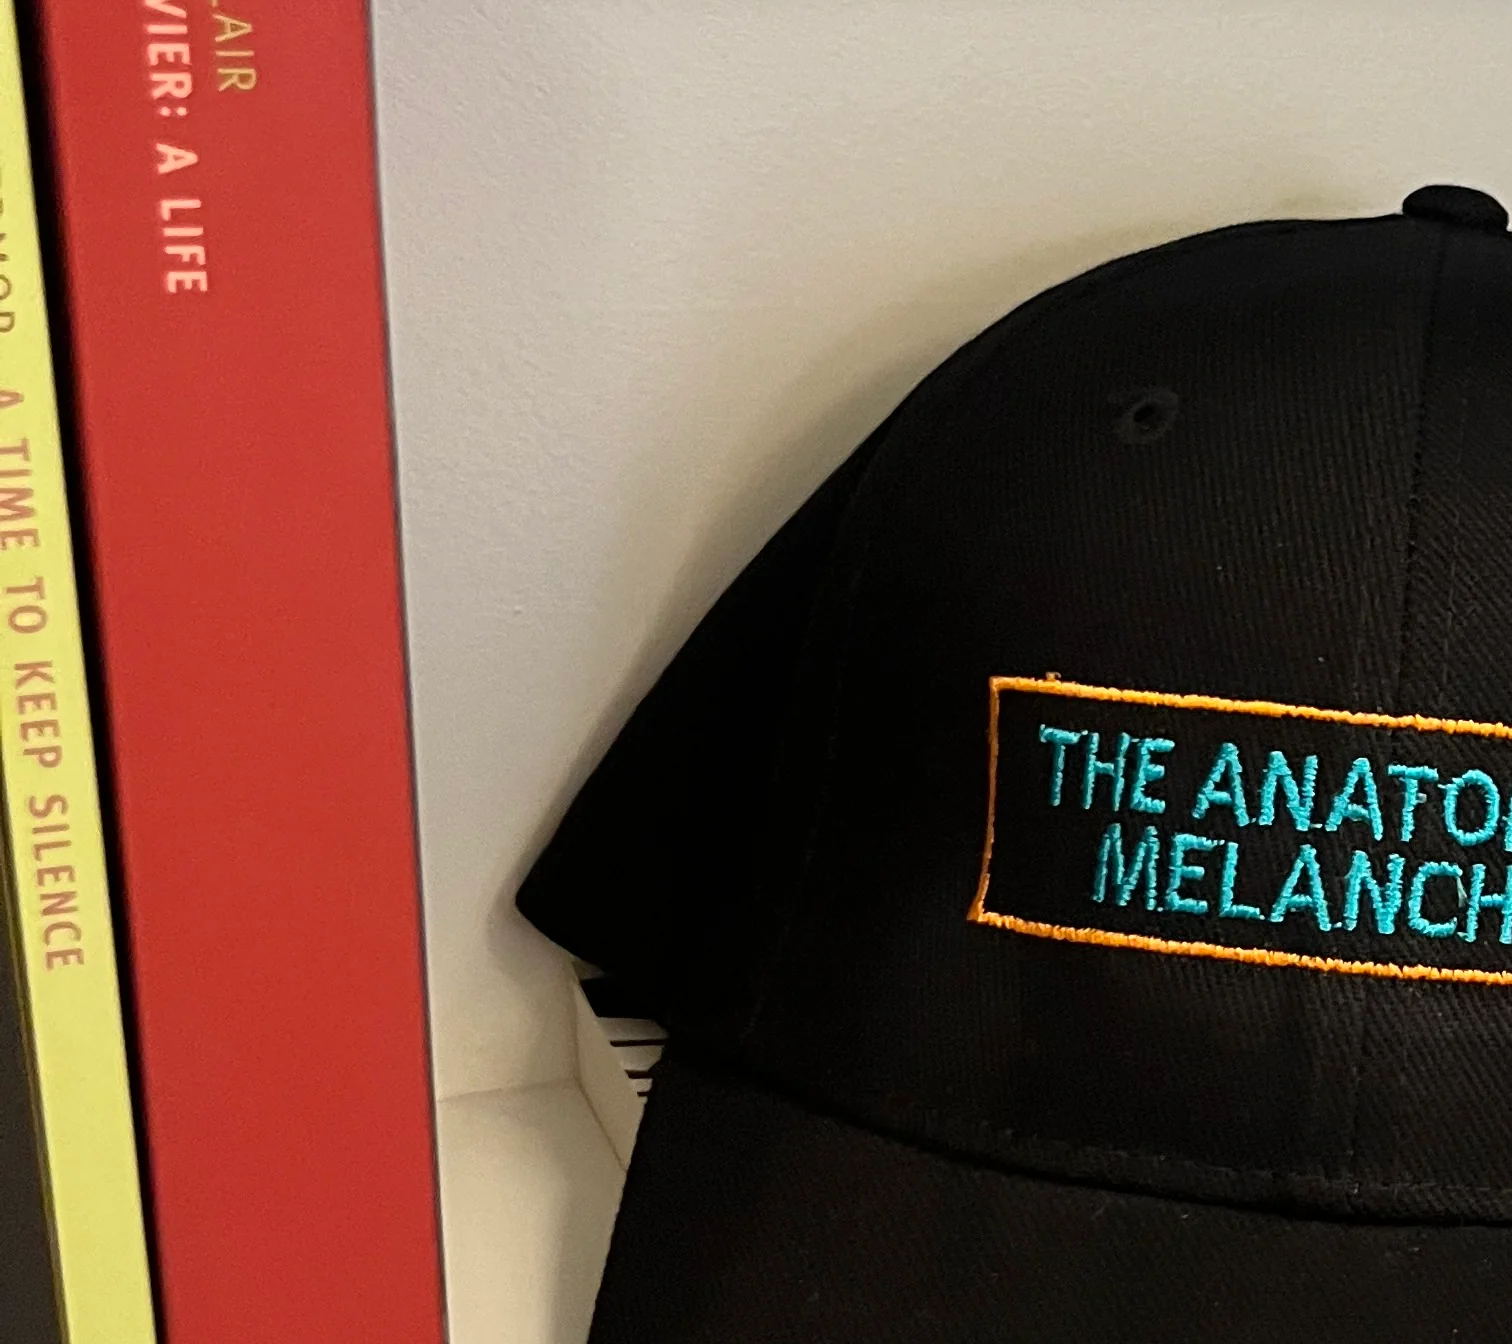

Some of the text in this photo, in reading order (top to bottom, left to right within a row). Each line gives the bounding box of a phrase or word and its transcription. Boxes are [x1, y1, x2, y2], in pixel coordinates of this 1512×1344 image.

[154, 141, 197, 172] A
[158, 198, 207, 293] LIFE
[0, 436, 38, 549] TIME
[5, 575, 47, 633] TO
[13, 658, 61, 768] KEEP
[1038, 723, 1176, 815] THE
[28, 793, 83, 970] SILENCE
